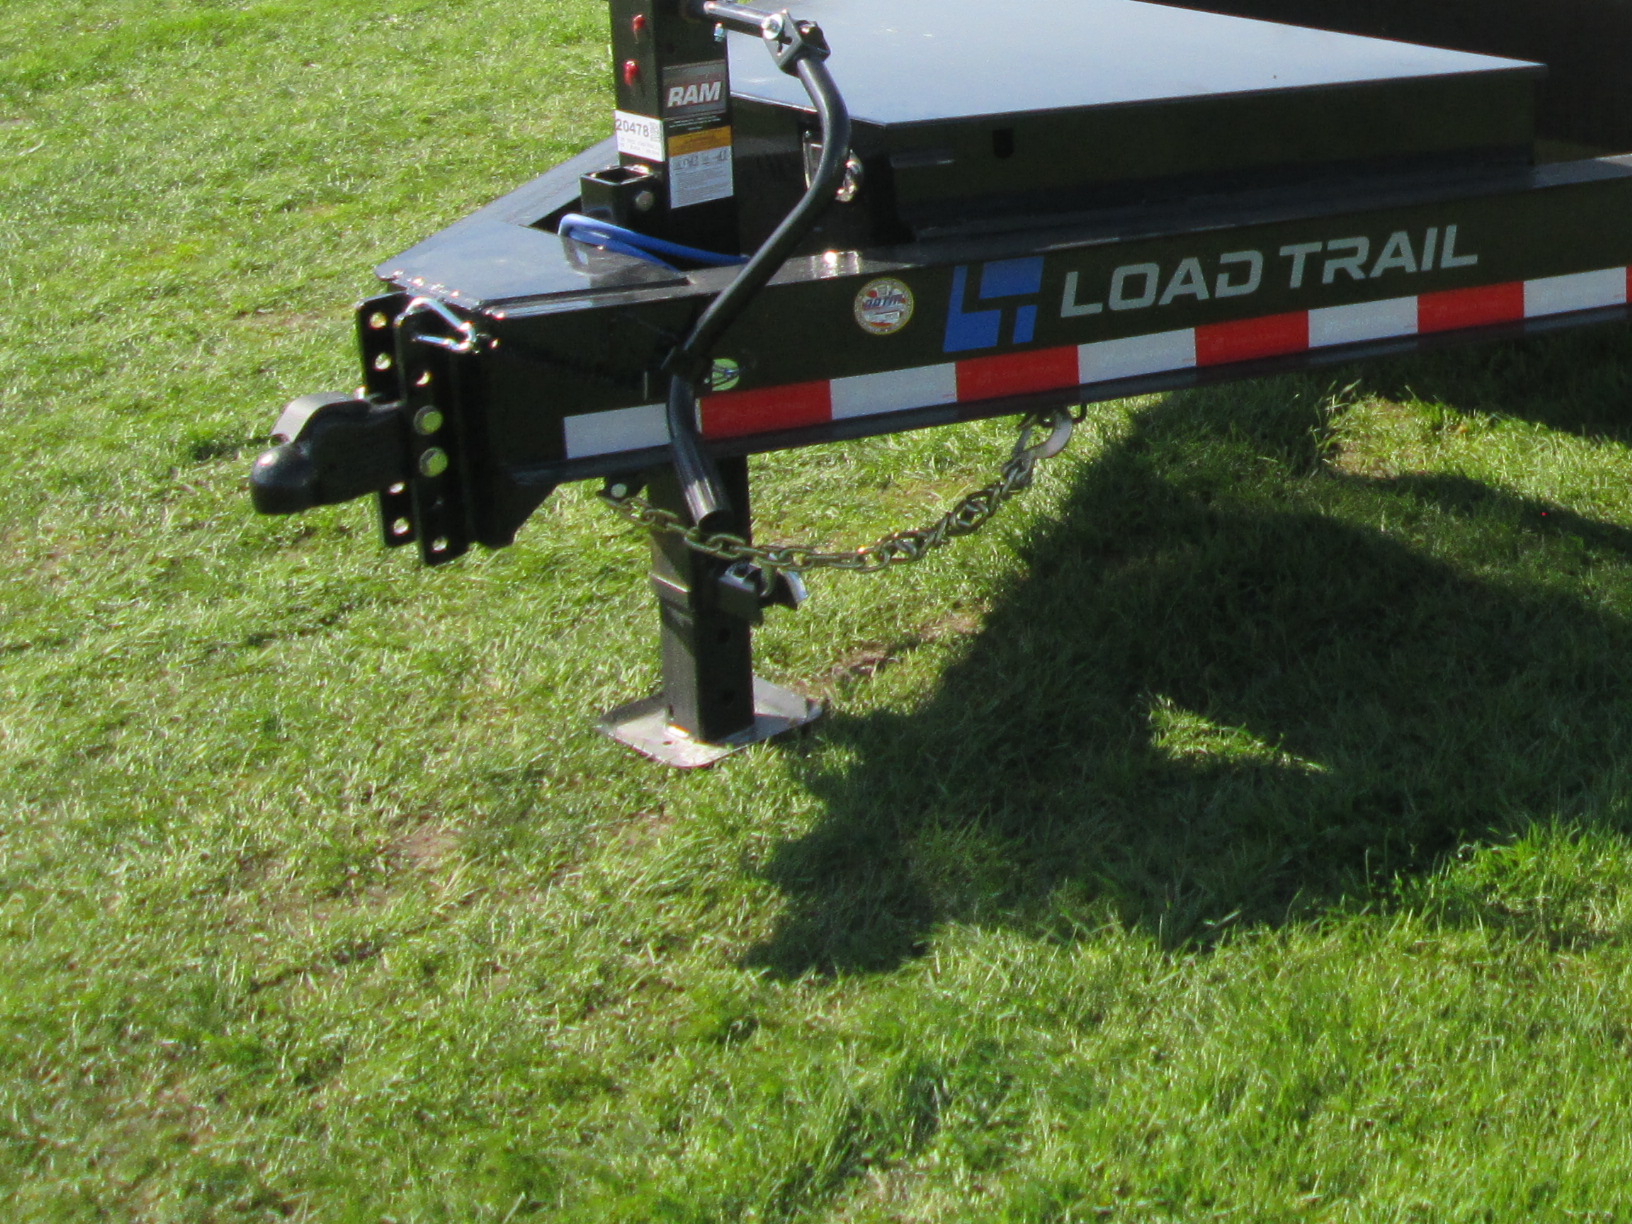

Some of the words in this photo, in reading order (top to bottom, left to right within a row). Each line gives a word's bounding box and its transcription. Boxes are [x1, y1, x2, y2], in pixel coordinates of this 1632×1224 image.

[667, 80, 721, 107] RAM
[1060, 250, 1264, 318] LOAD
[1279, 224, 1479, 290] TRAIL
